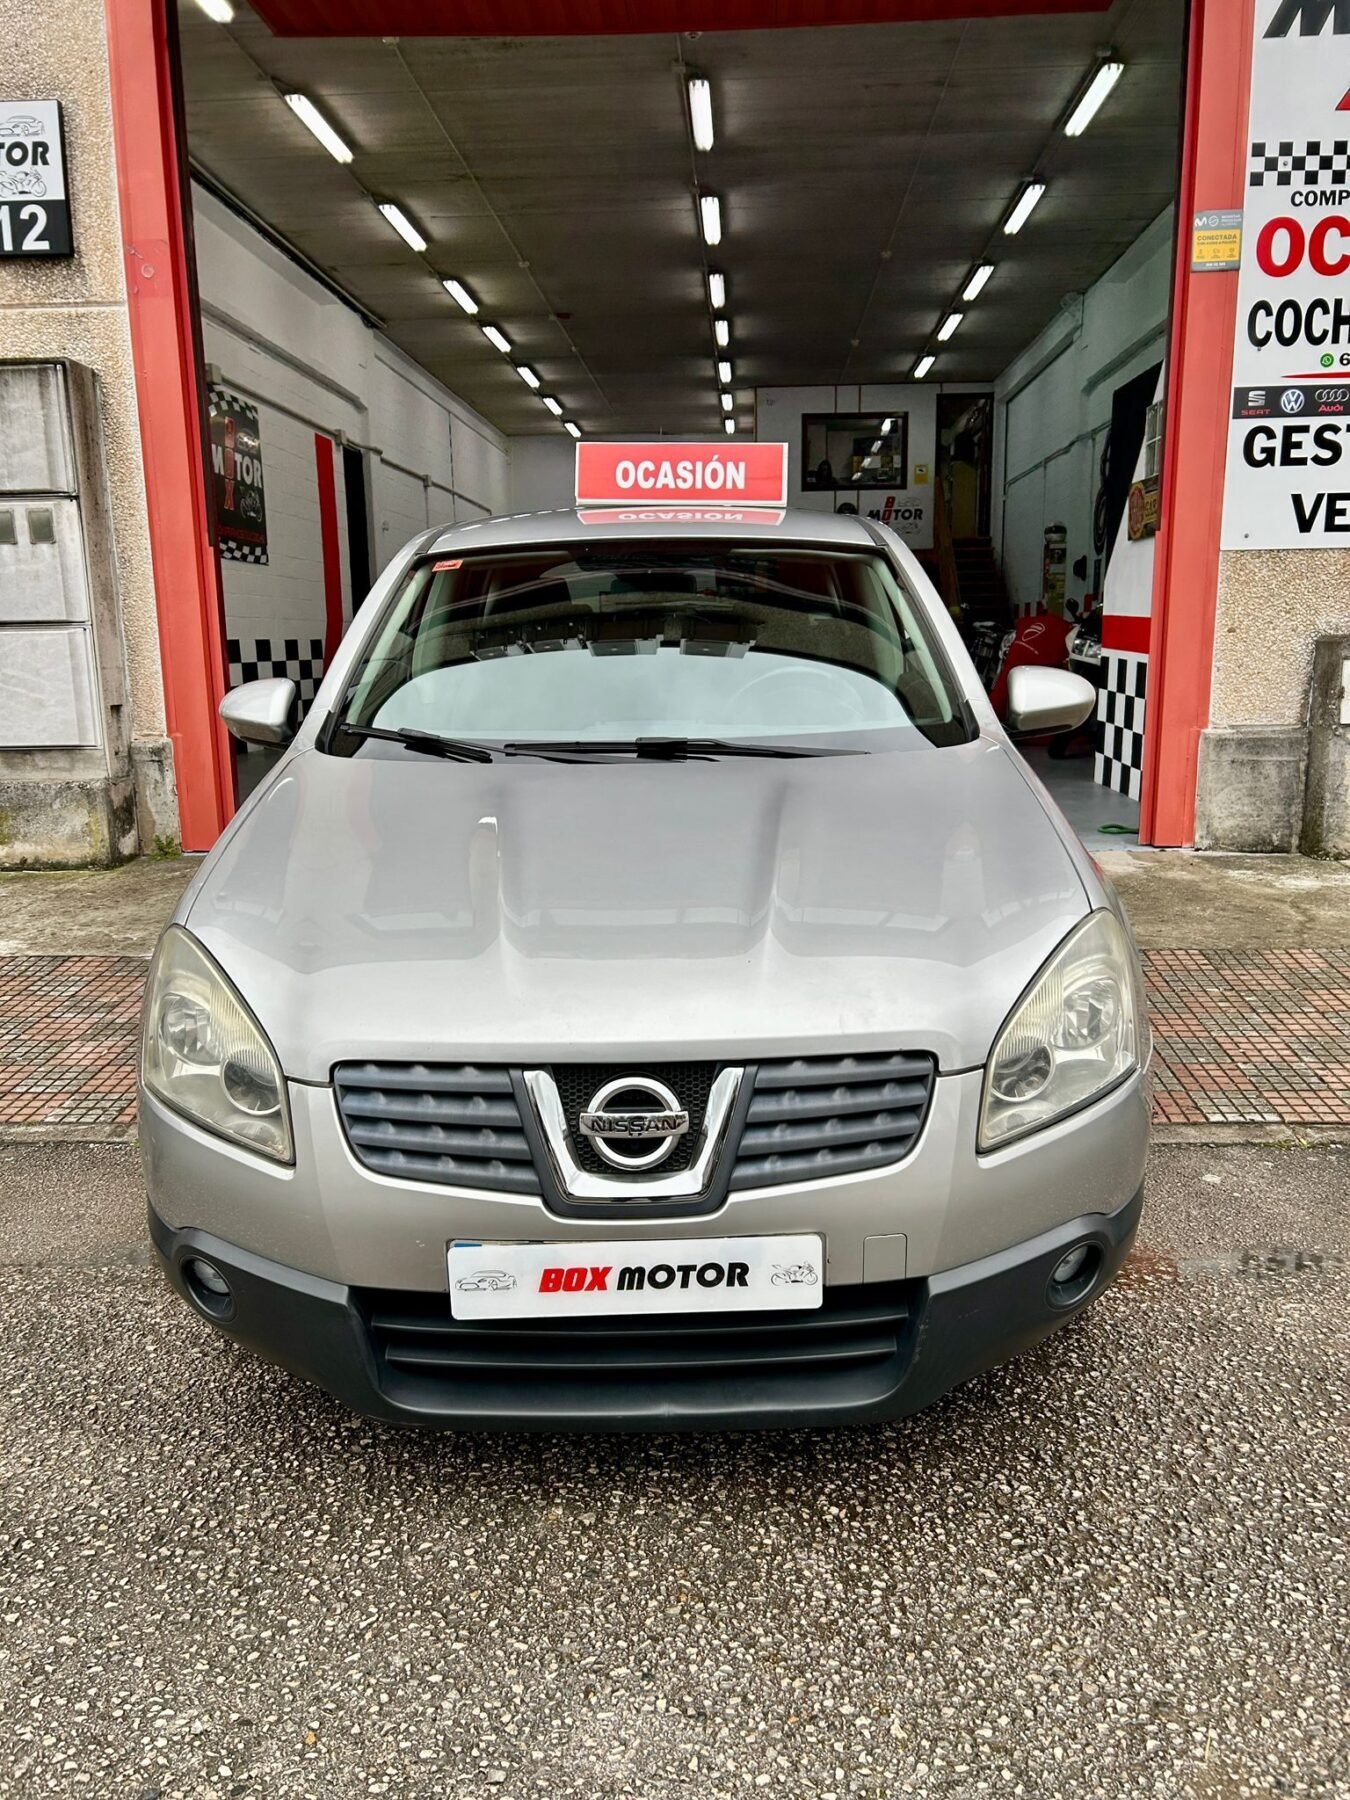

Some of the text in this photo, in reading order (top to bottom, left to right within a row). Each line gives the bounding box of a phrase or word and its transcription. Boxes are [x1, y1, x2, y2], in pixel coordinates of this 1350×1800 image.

[1290, 189, 1350, 207] COMP
[1197, 233, 1237, 242] CONECTADA
[1256, 215, 1350, 278] OC
[1241, 408, 1271, 416] SEAT
[1318, 404, 1344, 413] Audi
[1243, 422, 1350, 468] GES
[615, 454, 746, 490] OCASIÓN
[1291, 492, 1350, 533] VE
[591, 1118, 677, 1133] NISSAN
[538, 1262, 750, 1293] BOX MOTOR
